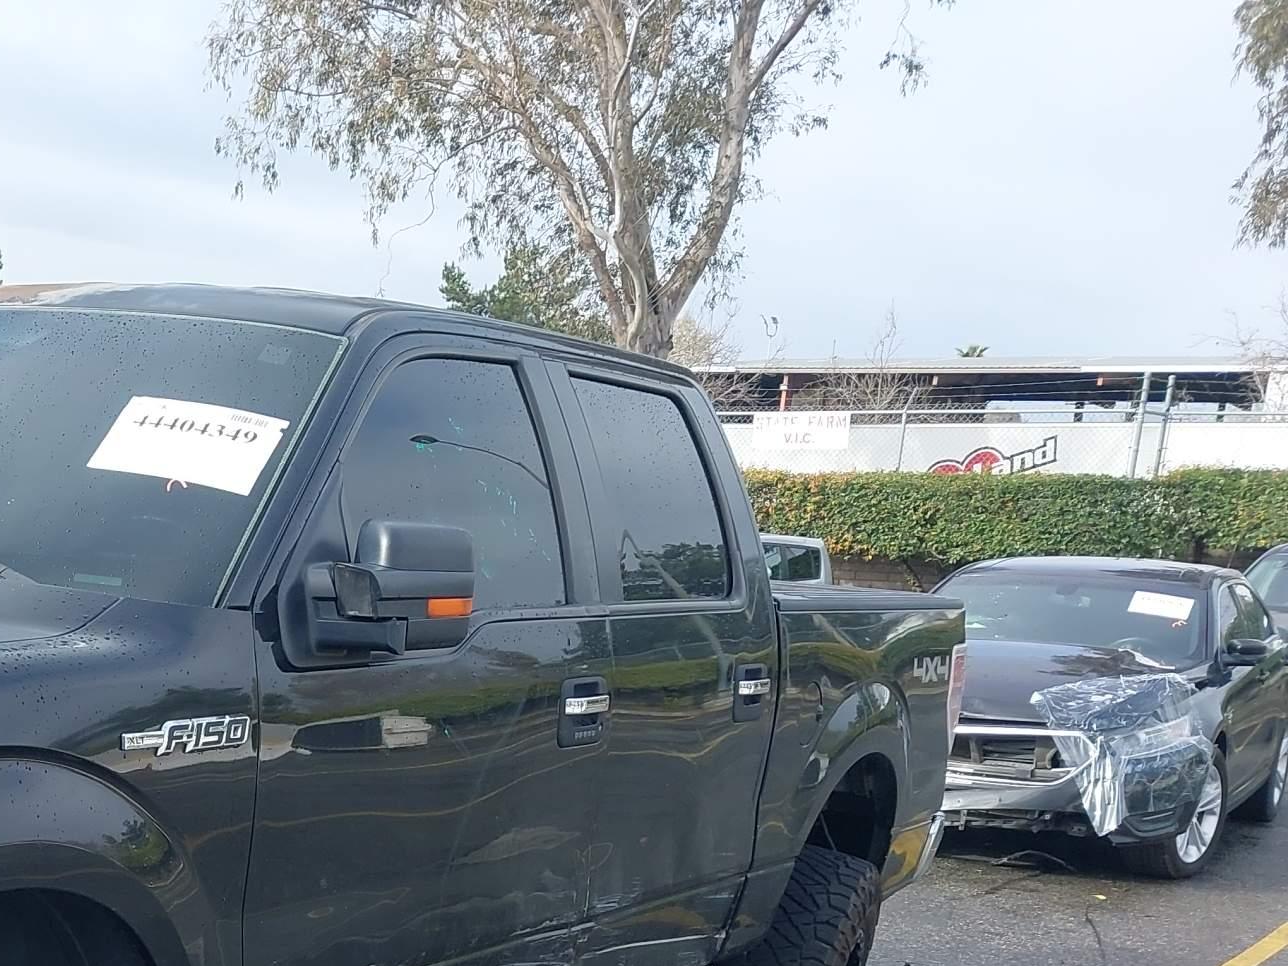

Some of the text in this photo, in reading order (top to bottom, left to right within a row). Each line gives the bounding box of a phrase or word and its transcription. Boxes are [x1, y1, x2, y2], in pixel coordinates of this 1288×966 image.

[132, 414, 258, 444] 44404349
[756, 415, 847, 431] STATE FARM
[161, 716, 249, 754] F-150
